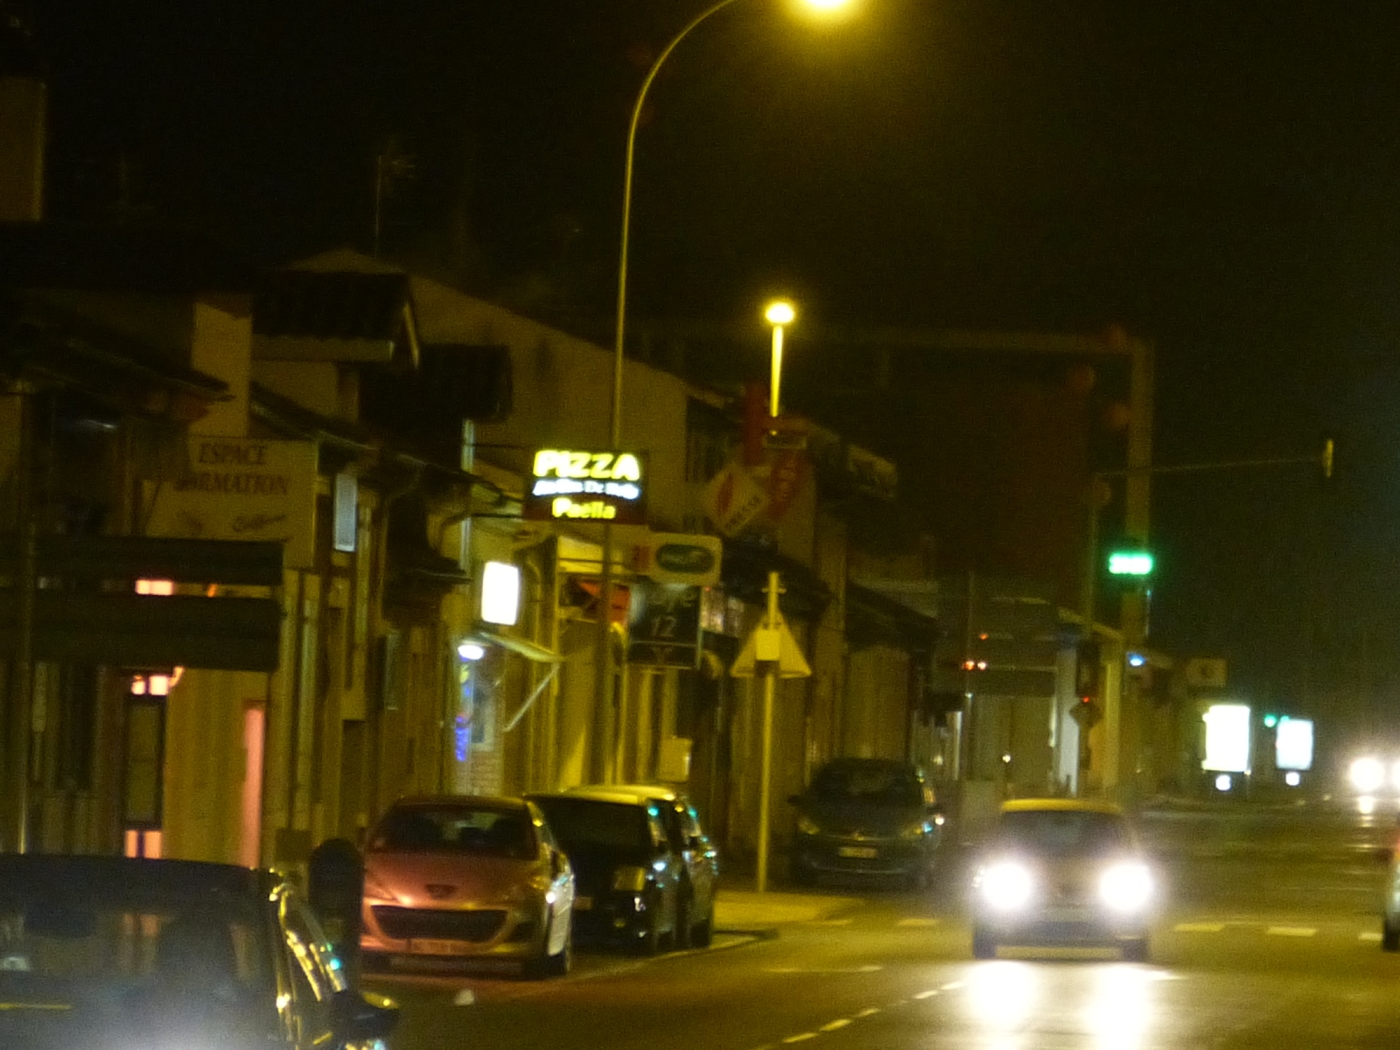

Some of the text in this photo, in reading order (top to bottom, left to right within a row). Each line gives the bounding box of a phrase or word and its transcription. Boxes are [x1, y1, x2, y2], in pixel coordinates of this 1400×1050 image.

[198, 442, 268, 466] ESPACE
[533, 449, 640, 481] PIZZA
[551, 497, 617, 521] Paella
